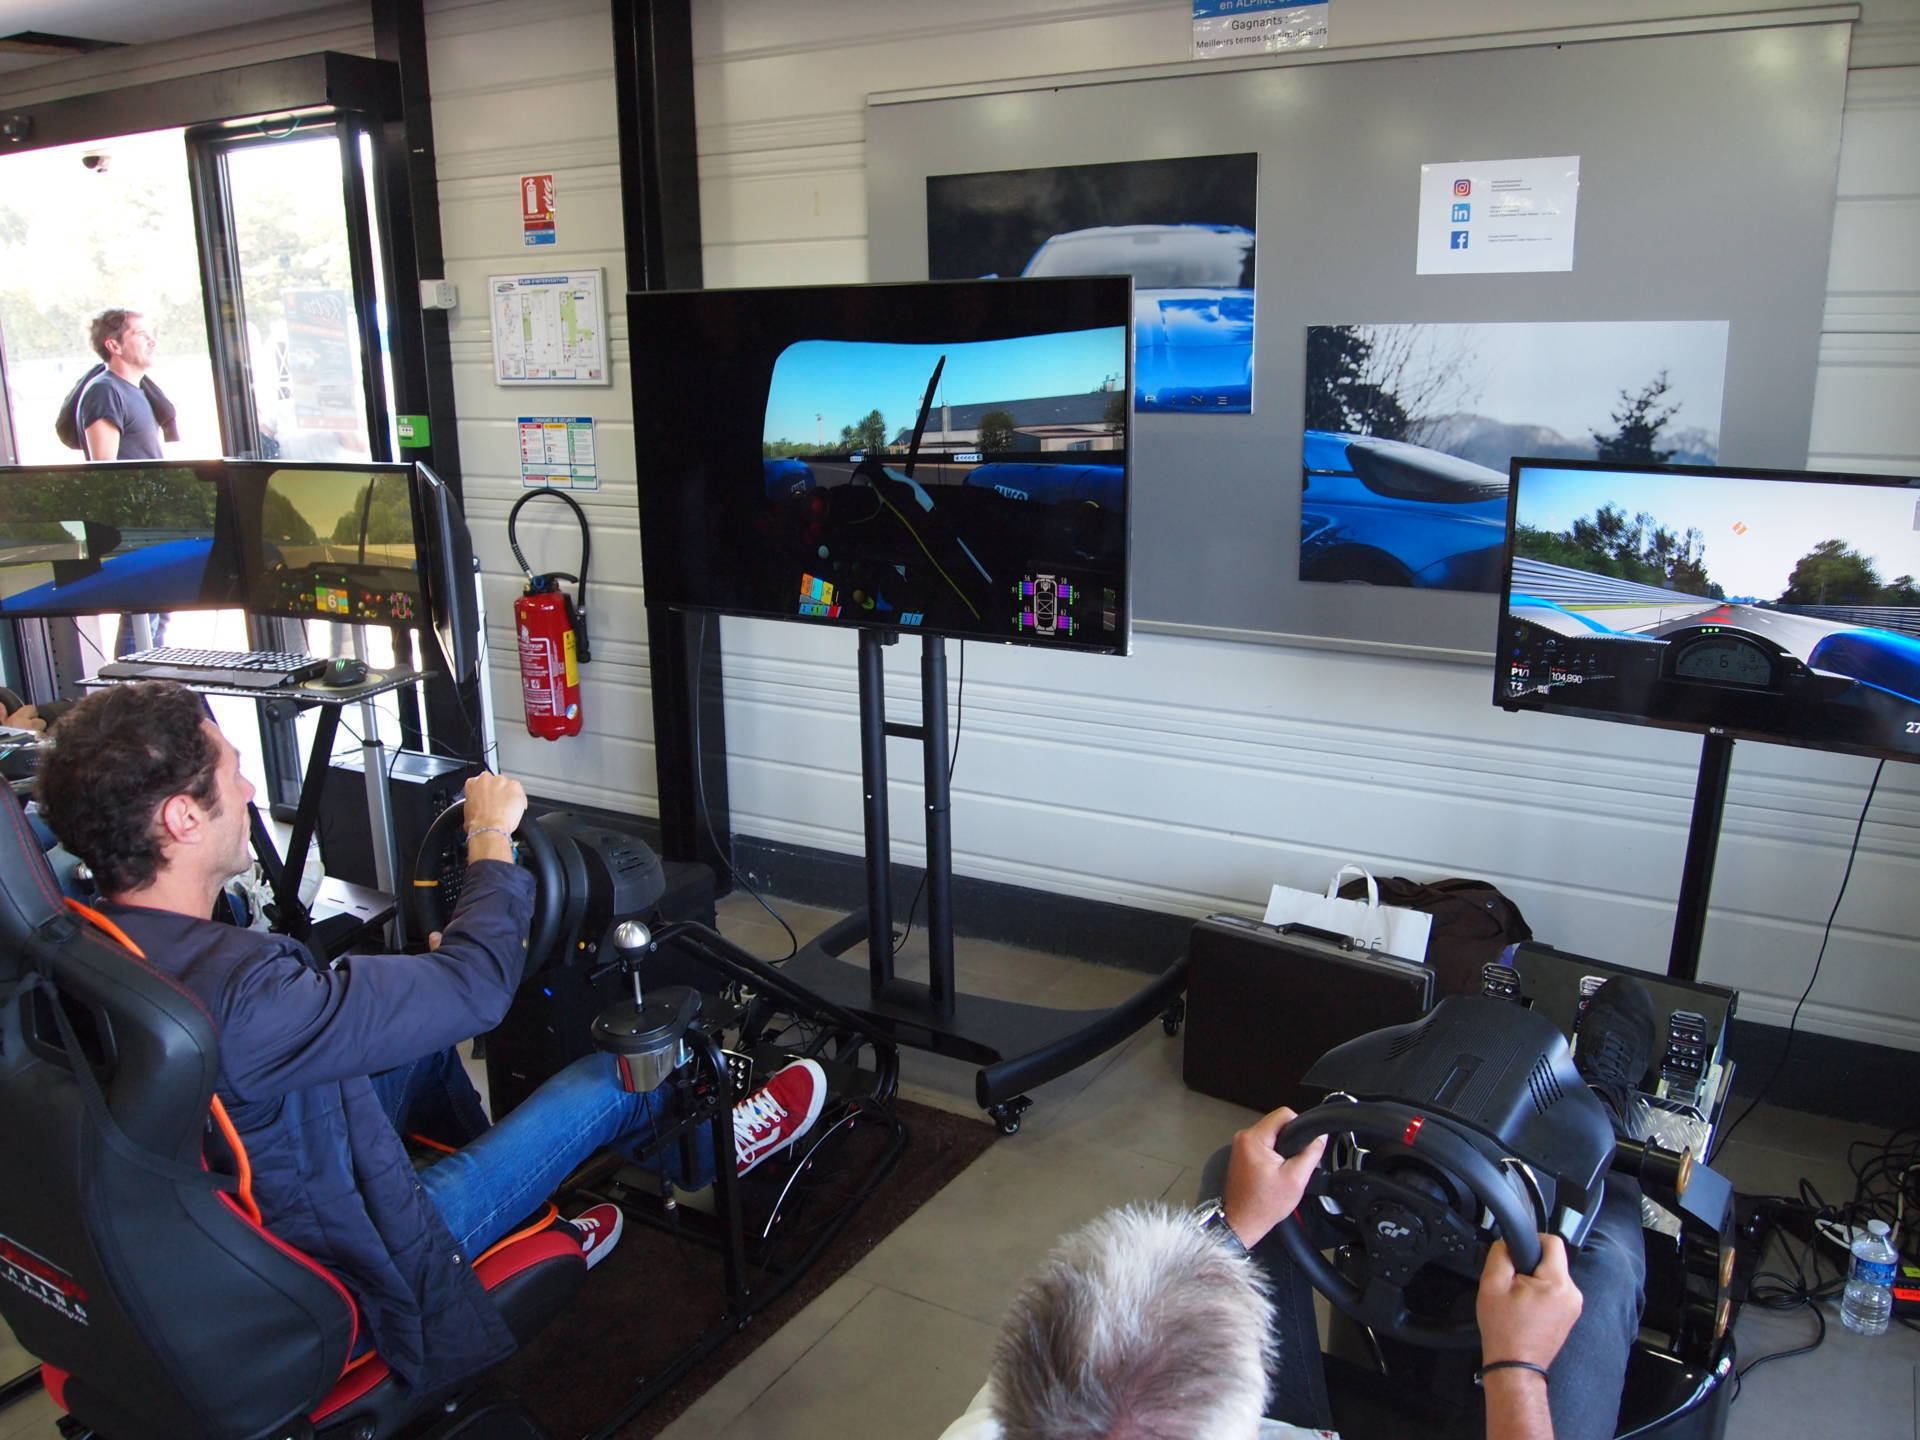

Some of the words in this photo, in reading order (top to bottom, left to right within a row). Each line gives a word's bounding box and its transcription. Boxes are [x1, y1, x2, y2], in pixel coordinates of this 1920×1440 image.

[1231, 16, 1282, 31] Gagnants
[1235, 35, 1261, 45] temps
[327, 594, 337, 609] 6
[1510, 681, 1523, 691] T2
